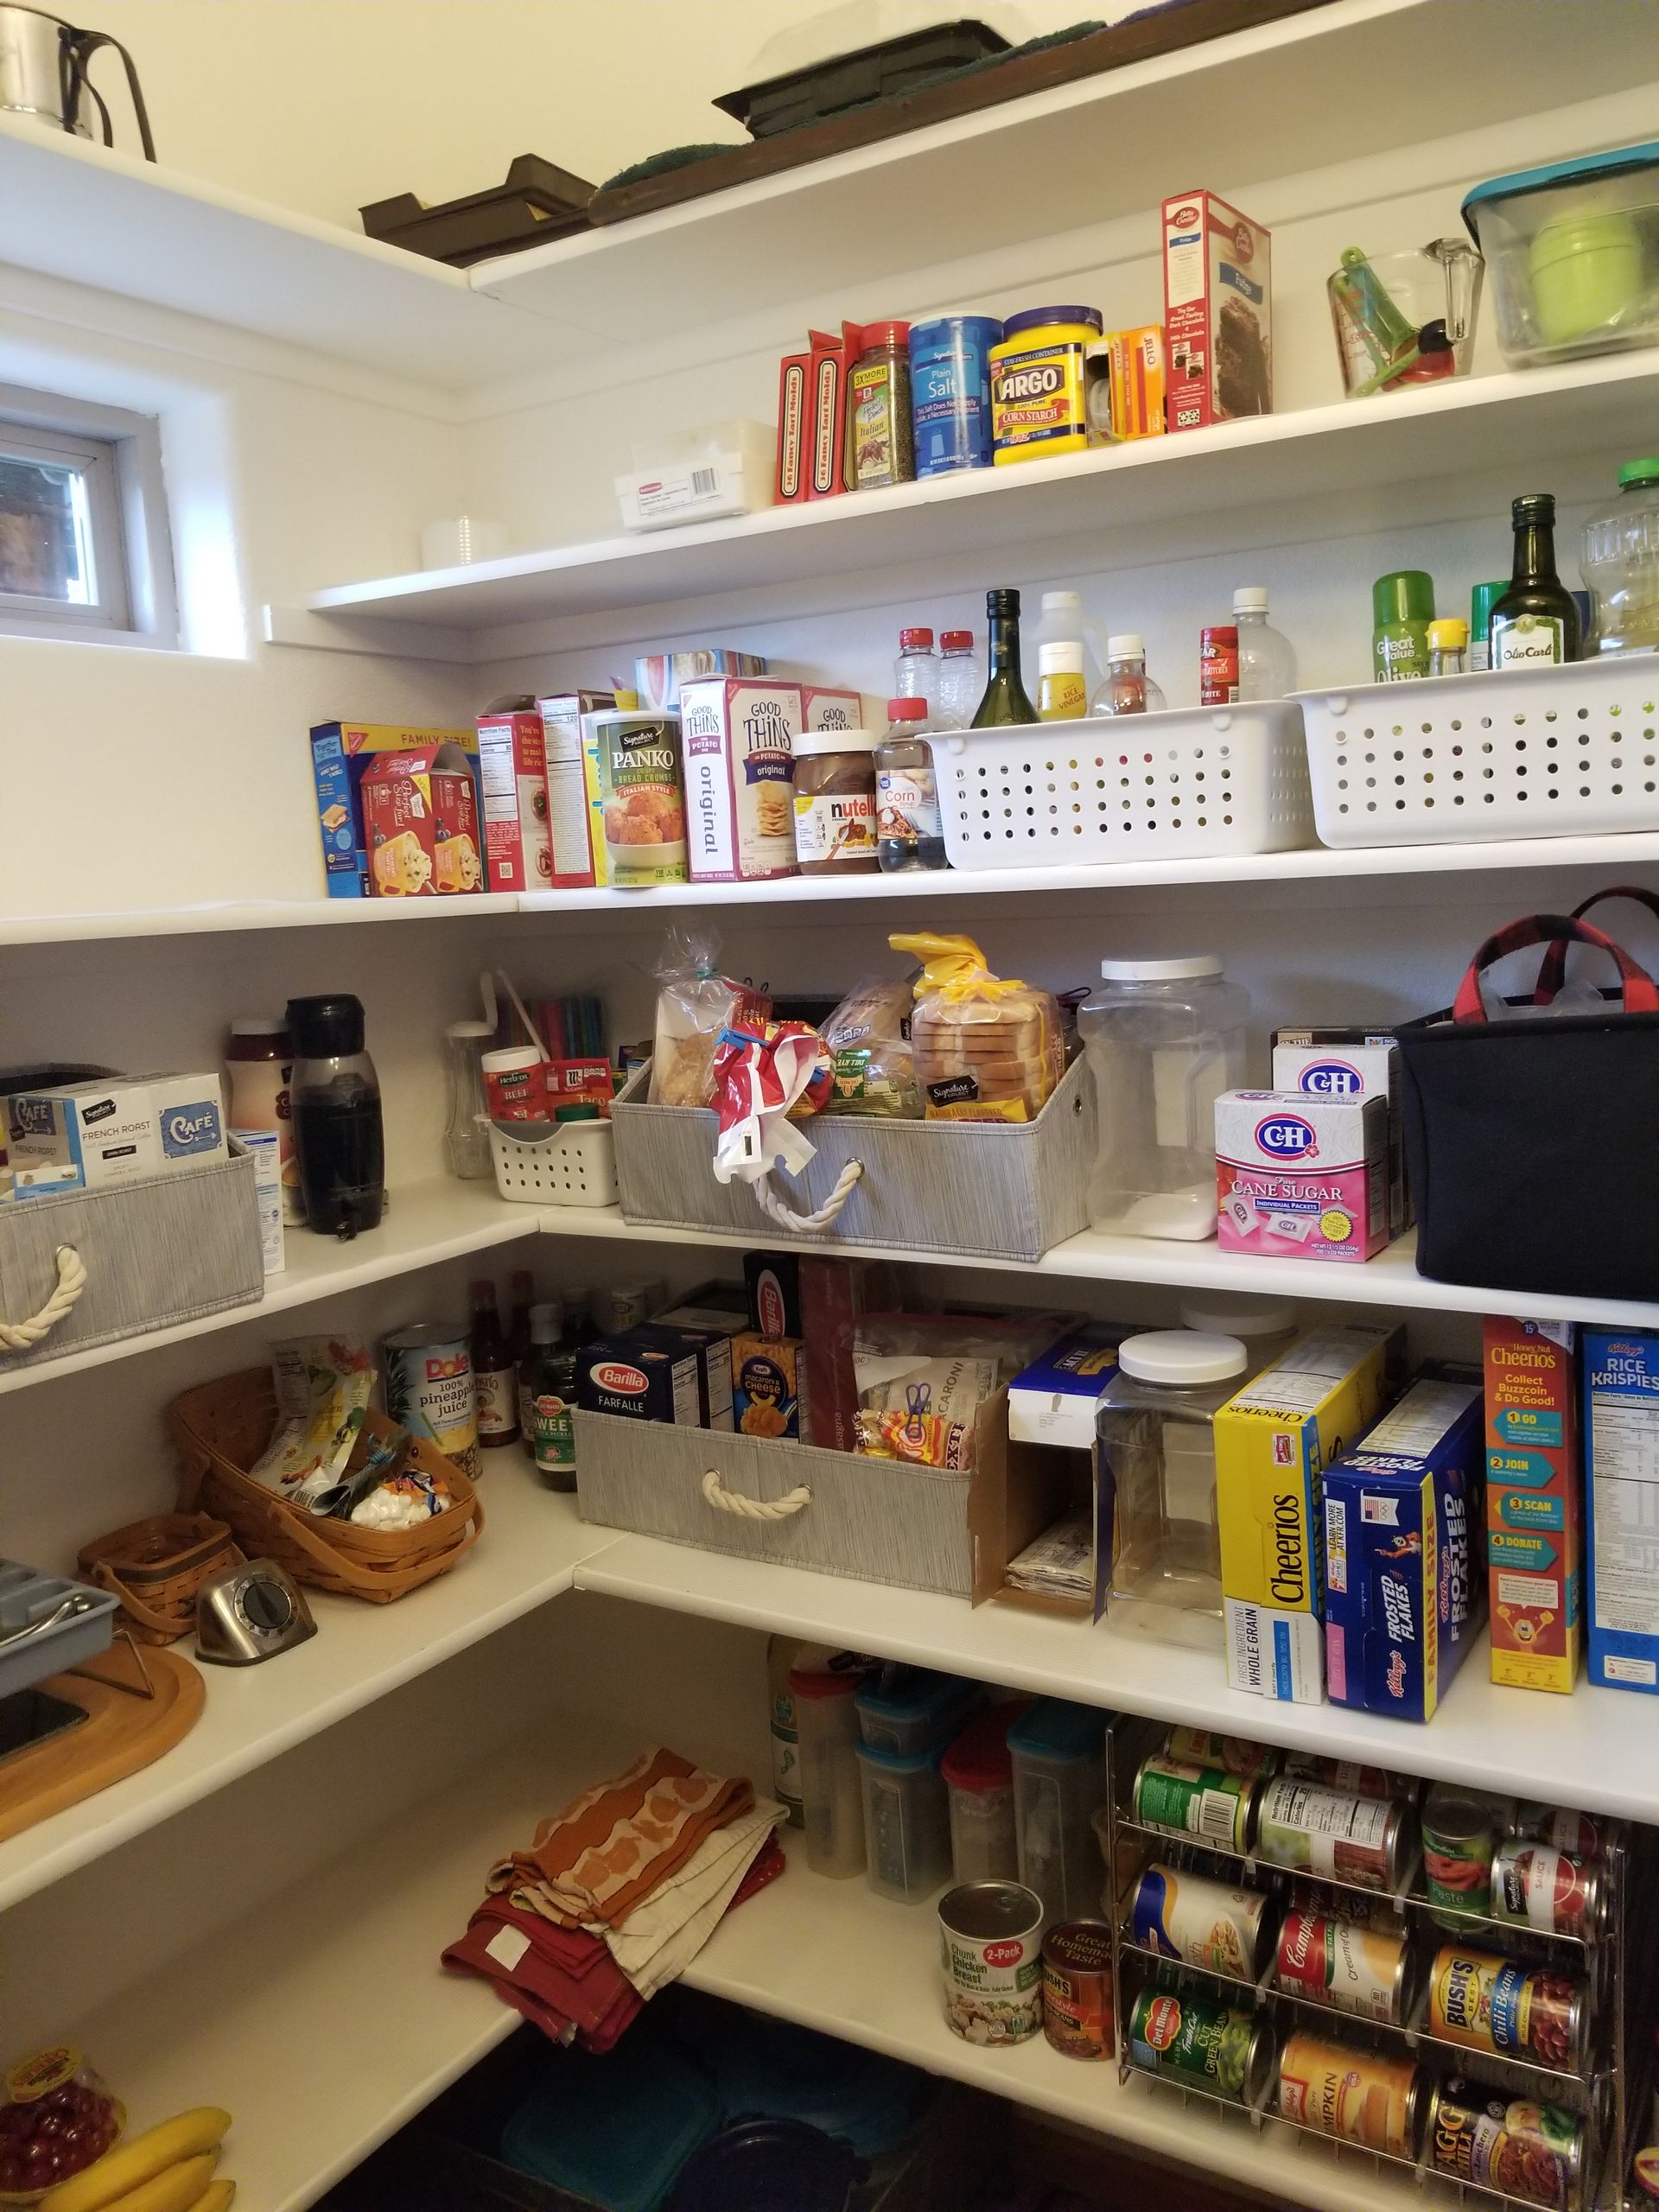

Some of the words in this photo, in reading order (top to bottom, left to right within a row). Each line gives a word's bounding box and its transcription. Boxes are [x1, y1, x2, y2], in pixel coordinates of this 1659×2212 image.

[864, 367, 886, 380] MORE
[931, 369, 951, 379] Plain
[928, 378, 957, 397] Salt
[1001, 369, 1058, 401] ARGO
[1002, 410, 1025, 423] CORN
[1026, 407, 1058, 420] STARCH
[1058, 693, 1085, 709] VINEGAR
[1063, 688, 1078, 698] RICE
[691, 705, 712, 716] GOOD
[751, 702, 781, 717] GOOD
[823, 709, 846, 722] GOOD
[401, 734, 439, 745] FAMILY
[624, 732, 653, 747] Signature
[691, 741, 717, 750] POTATO
[612, 750, 674, 771] PANKO
[645, 773, 672, 783] CRUMBS
[757, 765, 785, 777] original
[623, 785, 651, 796] ITALIAN
[652, 785, 671, 795] STYLE
[886, 791, 915, 802] Corn
[401, 779, 411, 822] Perfect
[700, 766, 718, 854] original
[1307, 1071, 1353, 1093] C&H
[505, 1089, 529, 1100] BEEF
[576, 1094, 606, 1107] Taco
[933, 1084, 969, 1099] Signature
[930, 1107, 968, 1119] NATURALLY
[969, 1107, 1002, 1116] FLAVORED
[83, 1127, 119, 1141] FRENCH
[122, 1121, 150, 1134] ROAST
[169, 1111, 214, 1144] CAFÉ
[1264, 1125, 1306, 1148] C&H
[1231, 1180, 1278, 1197] CANE
[1282, 1185, 1343, 1201] SUGAR
[1256, 1200, 1291, 1209] INDIVIDUAL
[1514, 1344, 1536, 1353] Honey
[1537, 1344, 1552, 1353] Nut
[1607, 1343, 1645, 1357] Kellogg's
[425, 1353, 468, 1379] Dole
[1491, 1347, 1555, 1369] Cheerios
[1607, 1358, 1645, 1374] RICE
[603, 1369, 644, 1388] Barilla
[755, 1365, 769, 1374] Kraft
[439, 1381, 464, 1392] 100%
[1498, 1382, 1548, 1395] Buzzcoin
[1505, 1374, 1543, 1385] Collect
[1592, 1371, 1659, 1391] KRISPIES
[938, 1362, 964, 1419] ACARONI
[437, 1400, 467, 1418] juice
[598, 1395, 645, 1414] FARFALLE
[1495, 1393, 1502, 1402] &
[1505, 1393, 1520, 1403] Do
[1522, 1395, 1555, 1407] Good!
[1227, 1406, 1303, 1423] Cheerios
[1522, 1414, 1537, 1424] GO
[1343, 1459, 1426, 1471] FROSTED
[1355, 1455, 1426, 1465] FLAKES
[1493, 1459, 1500, 1467] 2
[1505, 1459, 1529, 1471] JOIN
[1512, 1498, 1519, 1508] 3
[1524, 1500, 1552, 1511] SCAN
[1270, 1494, 1303, 1604] Cheerios
[1338, 1541, 1344, 1551] AT
[1426, 1512, 1434, 1578] SIZE
[1493, 1535, 1500, 1545] 4
[1506, 1536, 1542, 1550] DONATE
[1445, 1493, 1461, 1642] FROSTED
[1453, 1497, 1470, 1621] FLAKES
[1381, 1574, 1403, 1643] FROSTED
[1395, 1581, 1415, 1642] FLAKES
[1236, 1606, 1247, 1654] INGREDIENT
[1245, 1609, 1258, 1643] GRAIN
[1427, 1589, 1436, 1686] FAMILY
[1237, 1656, 1248, 1685] FIRST
[1249, 1645, 1262, 1687] WHOLE
[1386, 1649, 1408, 1699] Kellogg's
[1272, 1794, 1281, 1820] Nutrition
[1535, 1859, 1545, 1889] SAUCE
[1433, 1885, 1464, 1903] Paste
[1509, 1875, 1519, 1911] Signature
[1075, 1933, 1111, 1948] Great
[951, 1944, 976, 1961] Chunk
[987, 1946, 1021, 1960] 2-Pack
[1065, 1949, 1103, 1965] Taste
[952, 1955, 988, 1974] Chicken
[1341, 1946, 1358, 1980] Cream
[954, 1966, 982, 1984] Breast
[1044, 1971, 1070, 1995] USH'S
[1446, 1960, 1474, 2027] BUSH'S
[1496, 1969, 1516, 2008] Beans
[1156, 1999, 1173, 2031] Monte
[1182, 2029, 1194, 2055] Fresh
[1189, 2012, 1199, 2029] Cut
[1493, 2006, 1509, 2045] Chili
[1153, 2031, 1162, 2046] Del
[1198, 2025, 1211, 2046] CUT
[1205, 2039, 1219, 2074] GREEN
[1286, 2086, 1298, 2113] Libby's
